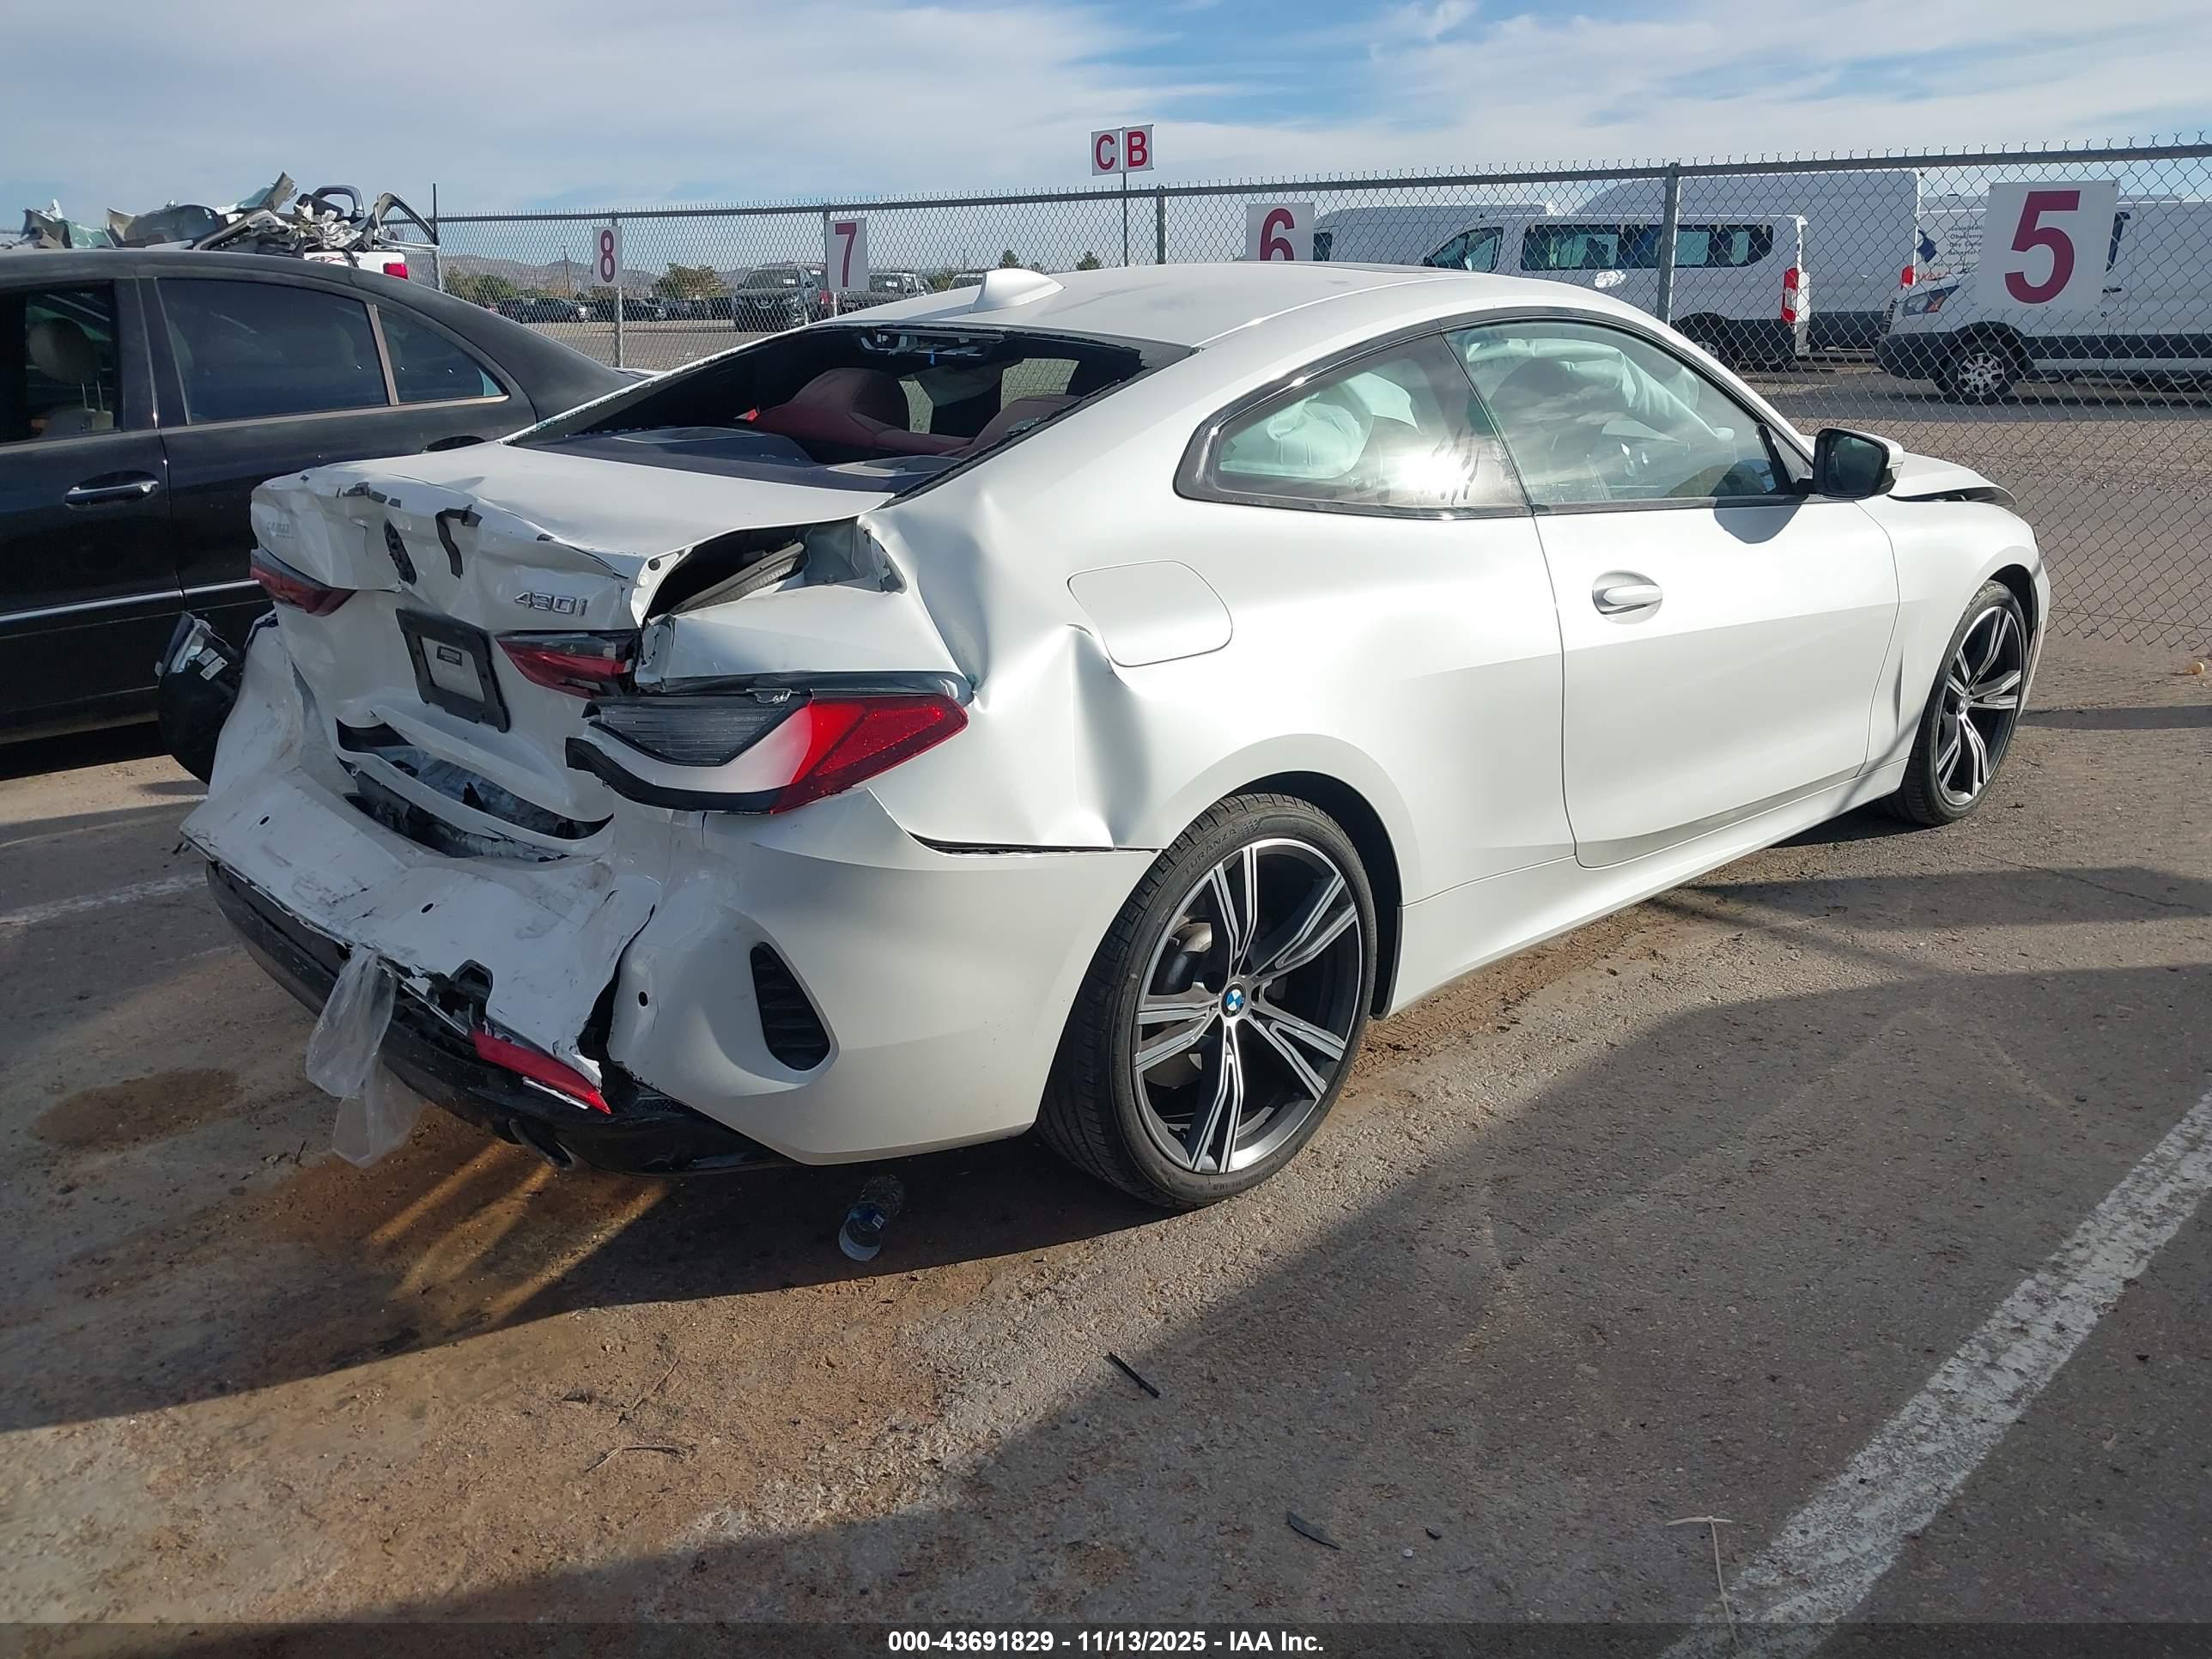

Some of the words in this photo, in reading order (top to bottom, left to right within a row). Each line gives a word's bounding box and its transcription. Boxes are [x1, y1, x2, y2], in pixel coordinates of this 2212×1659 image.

[1095, 134, 1116, 170] C
[1127, 130, 1149, 168] B
[599, 228, 617, 283] 8
[835, 222, 857, 287] 7
[1259, 207, 1296, 261] 6
[2004, 190, 2081, 304] 5
[514, 591, 588, 617] 430i
